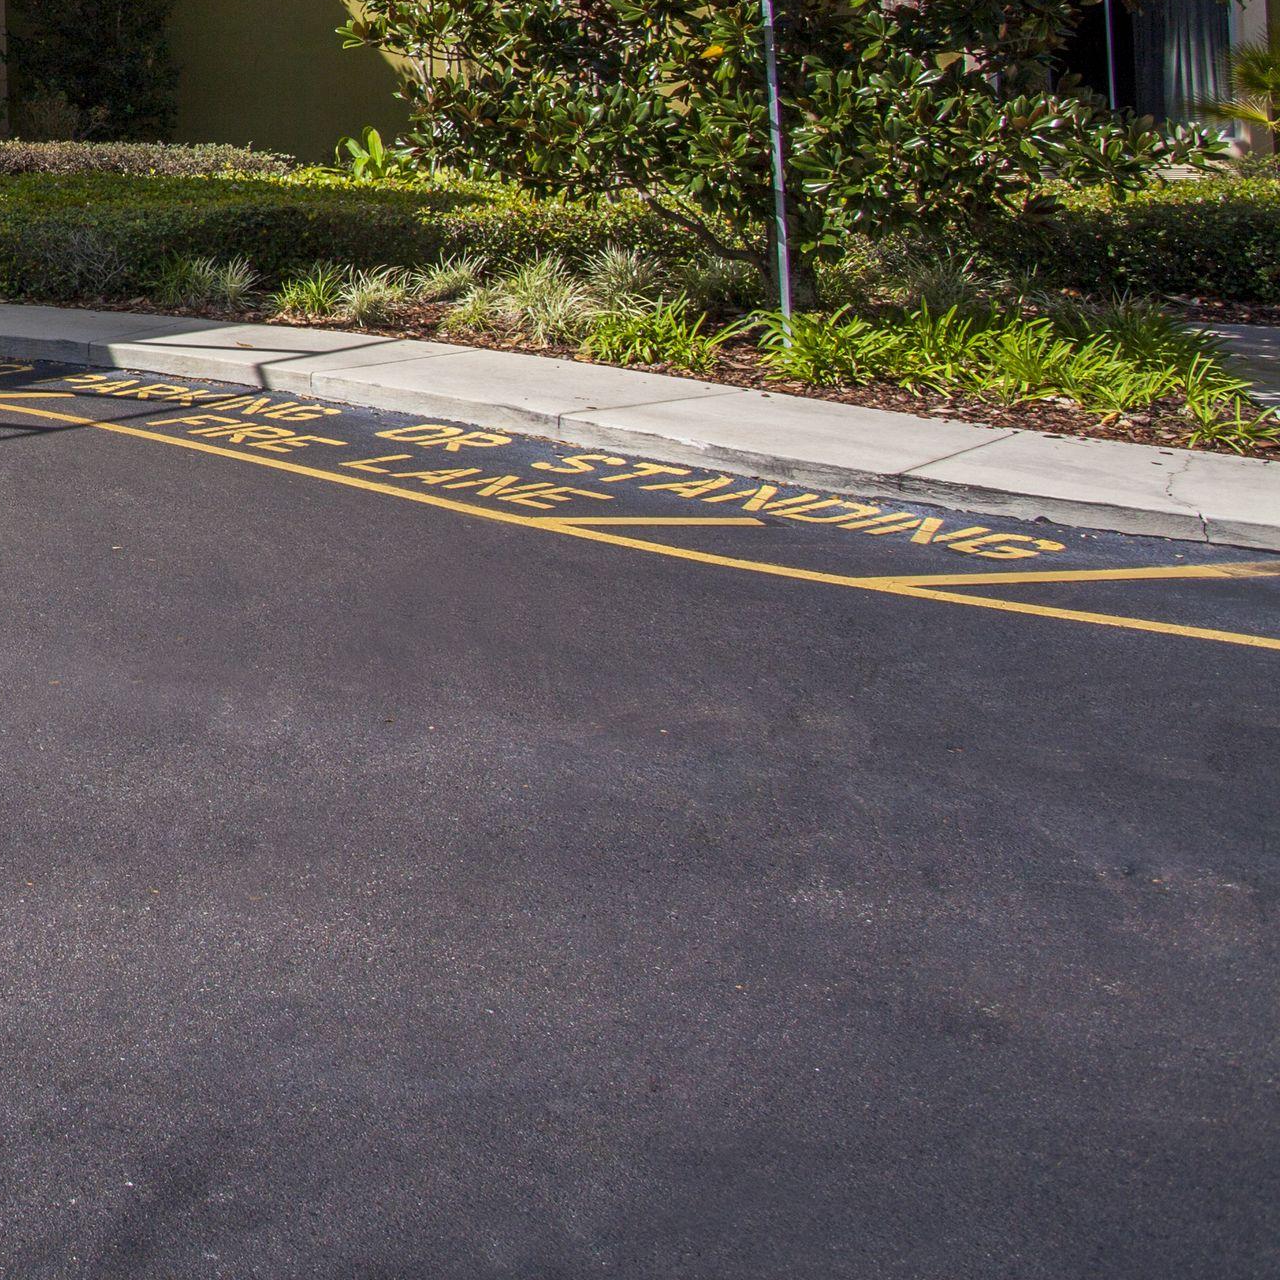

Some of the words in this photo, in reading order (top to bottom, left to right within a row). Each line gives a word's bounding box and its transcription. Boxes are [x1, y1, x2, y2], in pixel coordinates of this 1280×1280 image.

[33, 370, 342, 421] PARKING
[374, 424, 512, 452] OR
[530, 454, 1067, 559] STANDING
[146, 414, 349, 453] FIRE
[338, 454, 615, 510] LANE
